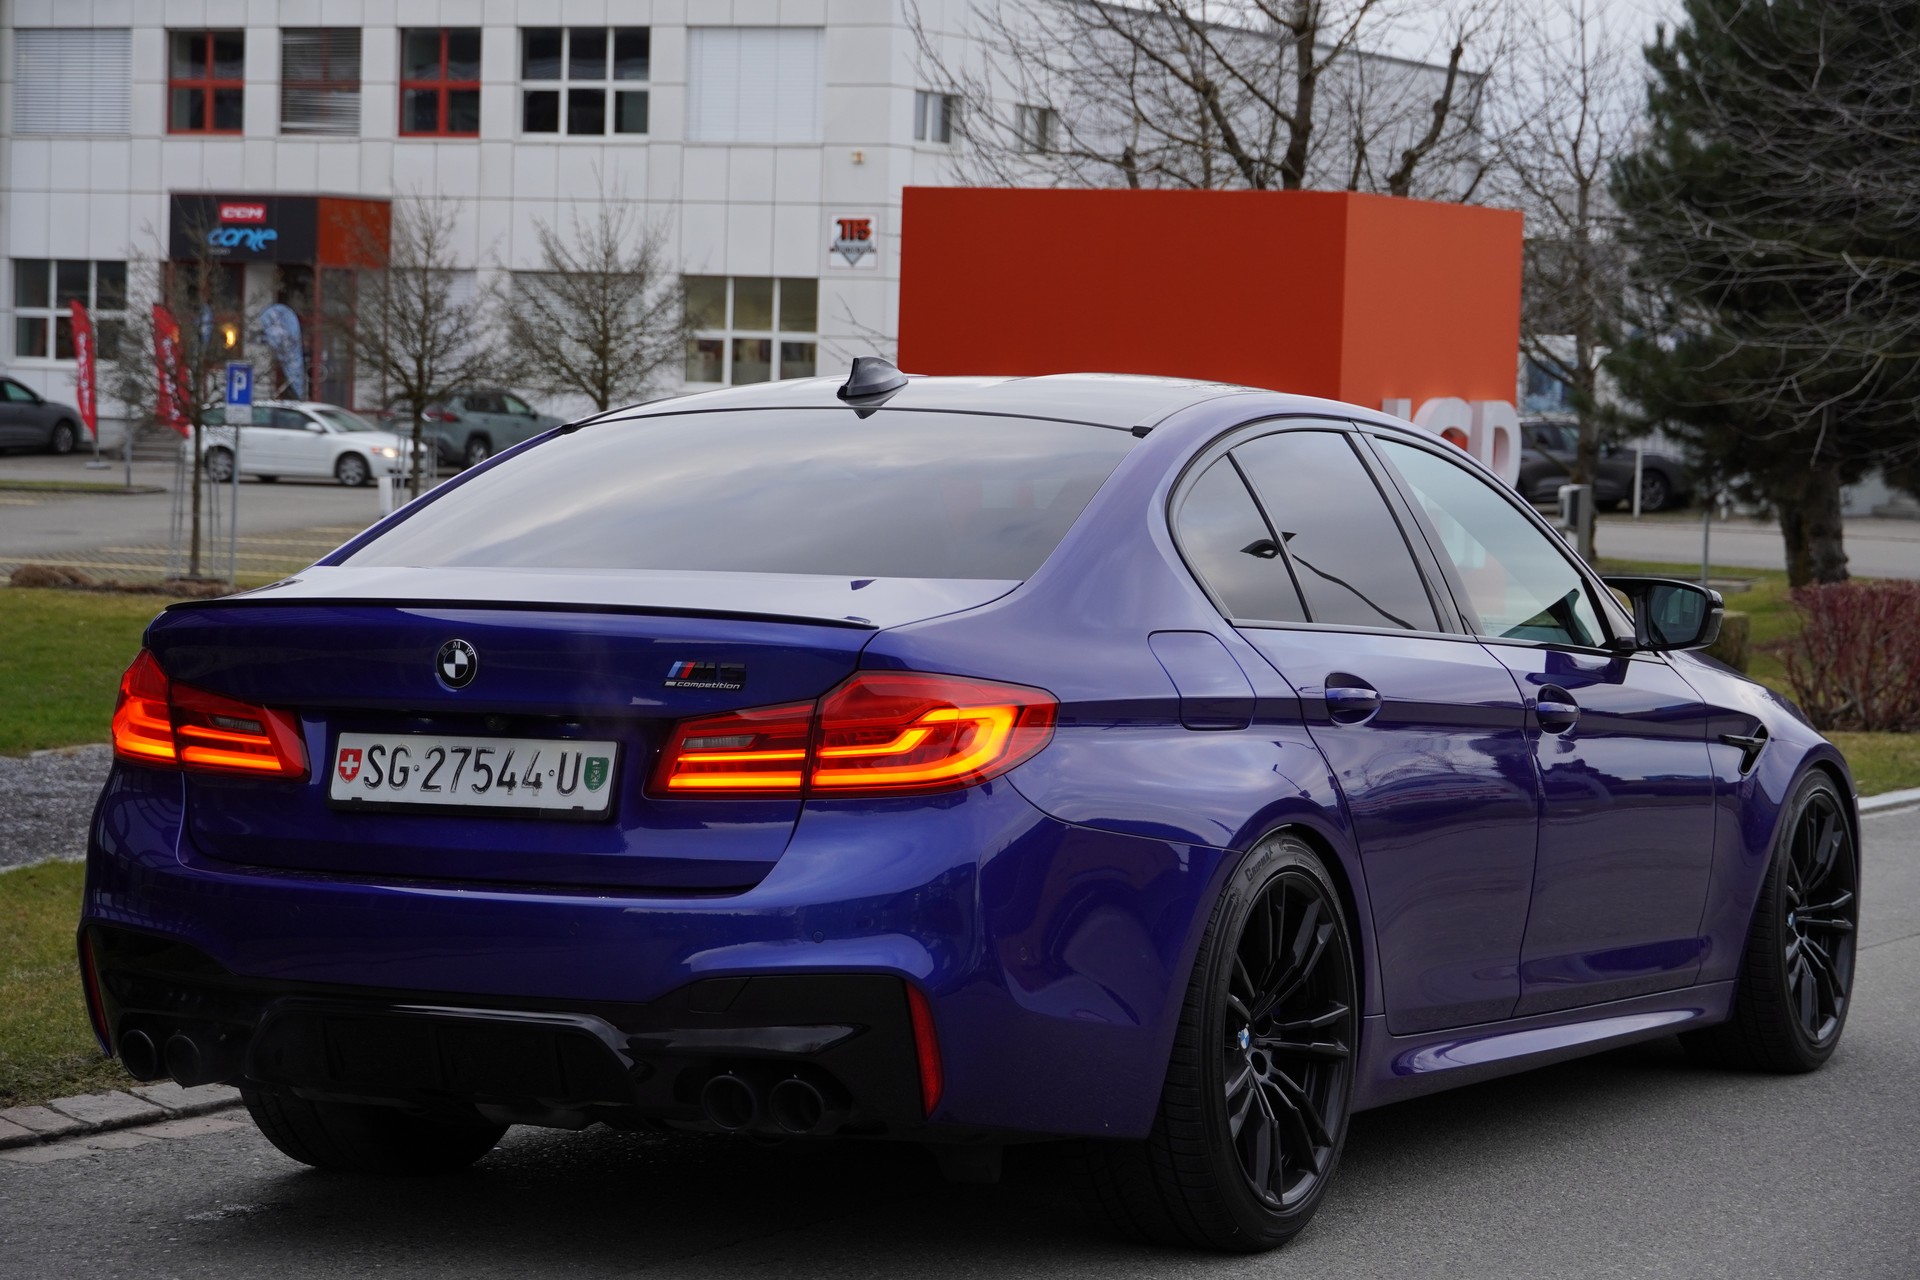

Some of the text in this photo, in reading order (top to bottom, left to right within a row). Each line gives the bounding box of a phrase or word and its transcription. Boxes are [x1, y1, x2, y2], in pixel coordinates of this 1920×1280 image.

[221, 206, 264, 218] CCM
[231, 370, 247, 401] P
[440, 641, 475, 657] BMW
[676, 681, 741, 690] competition
